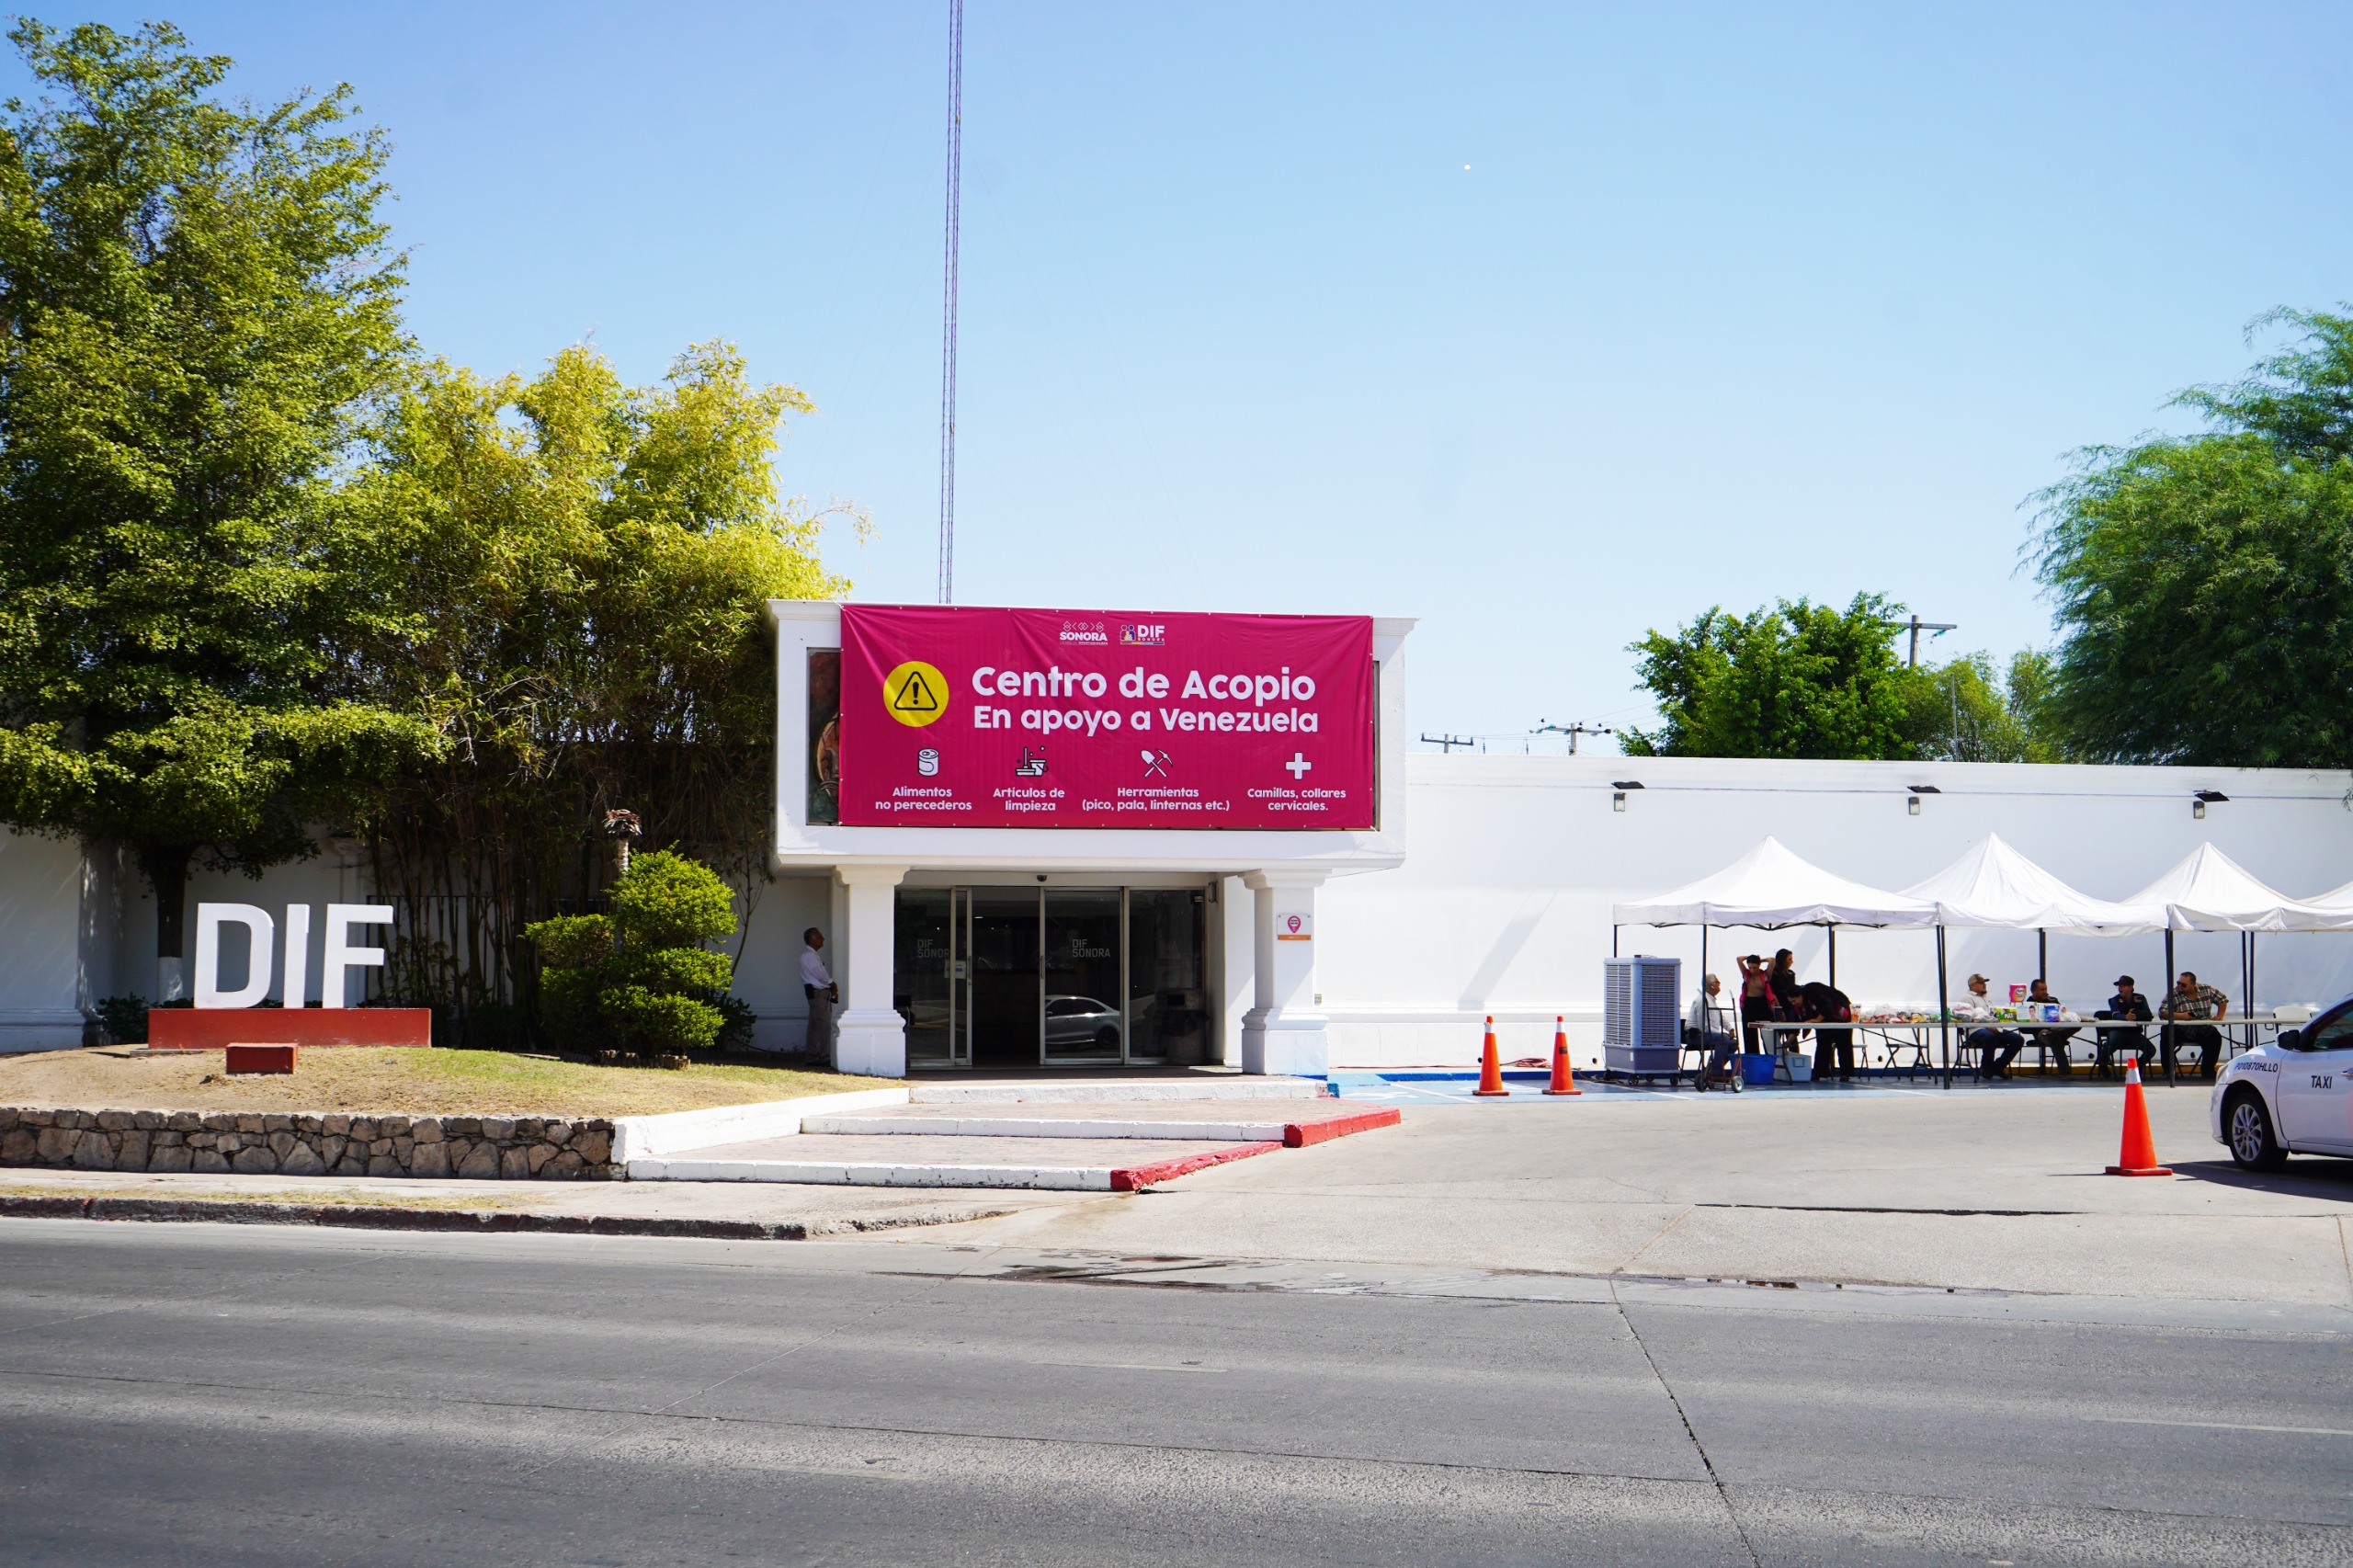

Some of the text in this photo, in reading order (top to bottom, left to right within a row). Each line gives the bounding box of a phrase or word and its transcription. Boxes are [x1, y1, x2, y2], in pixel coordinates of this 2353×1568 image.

[1060, 631, 1108, 642] SONORA
[1137, 625, 1165, 638] DIF
[972, 665, 1316, 707] Centro de Acopio
[974, 705, 1318, 737] En apoyo a Venezuela
[892, 786, 952, 798] Alimentos
[1049, 788, 1065, 798] de
[1117, 786, 1199, 798] Herramientas
[1247, 787, 1347, 800] Camillas, collares
[875, 800, 972, 812] no perecederos
[1005, 800, 1056, 813] limpieza
[1082, 799, 1230, 812] (pico, pala, linternas etc.)
[1267, 800, 1329, 811] cervicales.
[917, 939, 933, 949] DIF
[1073, 938, 1087, 949] DIF
[194, 903, 393, 1009] DIF
[917, 949, 950, 958] SONOR
[1073, 948, 1111, 958] SONORA
[2311, 1075, 2333, 1089] TAXI
